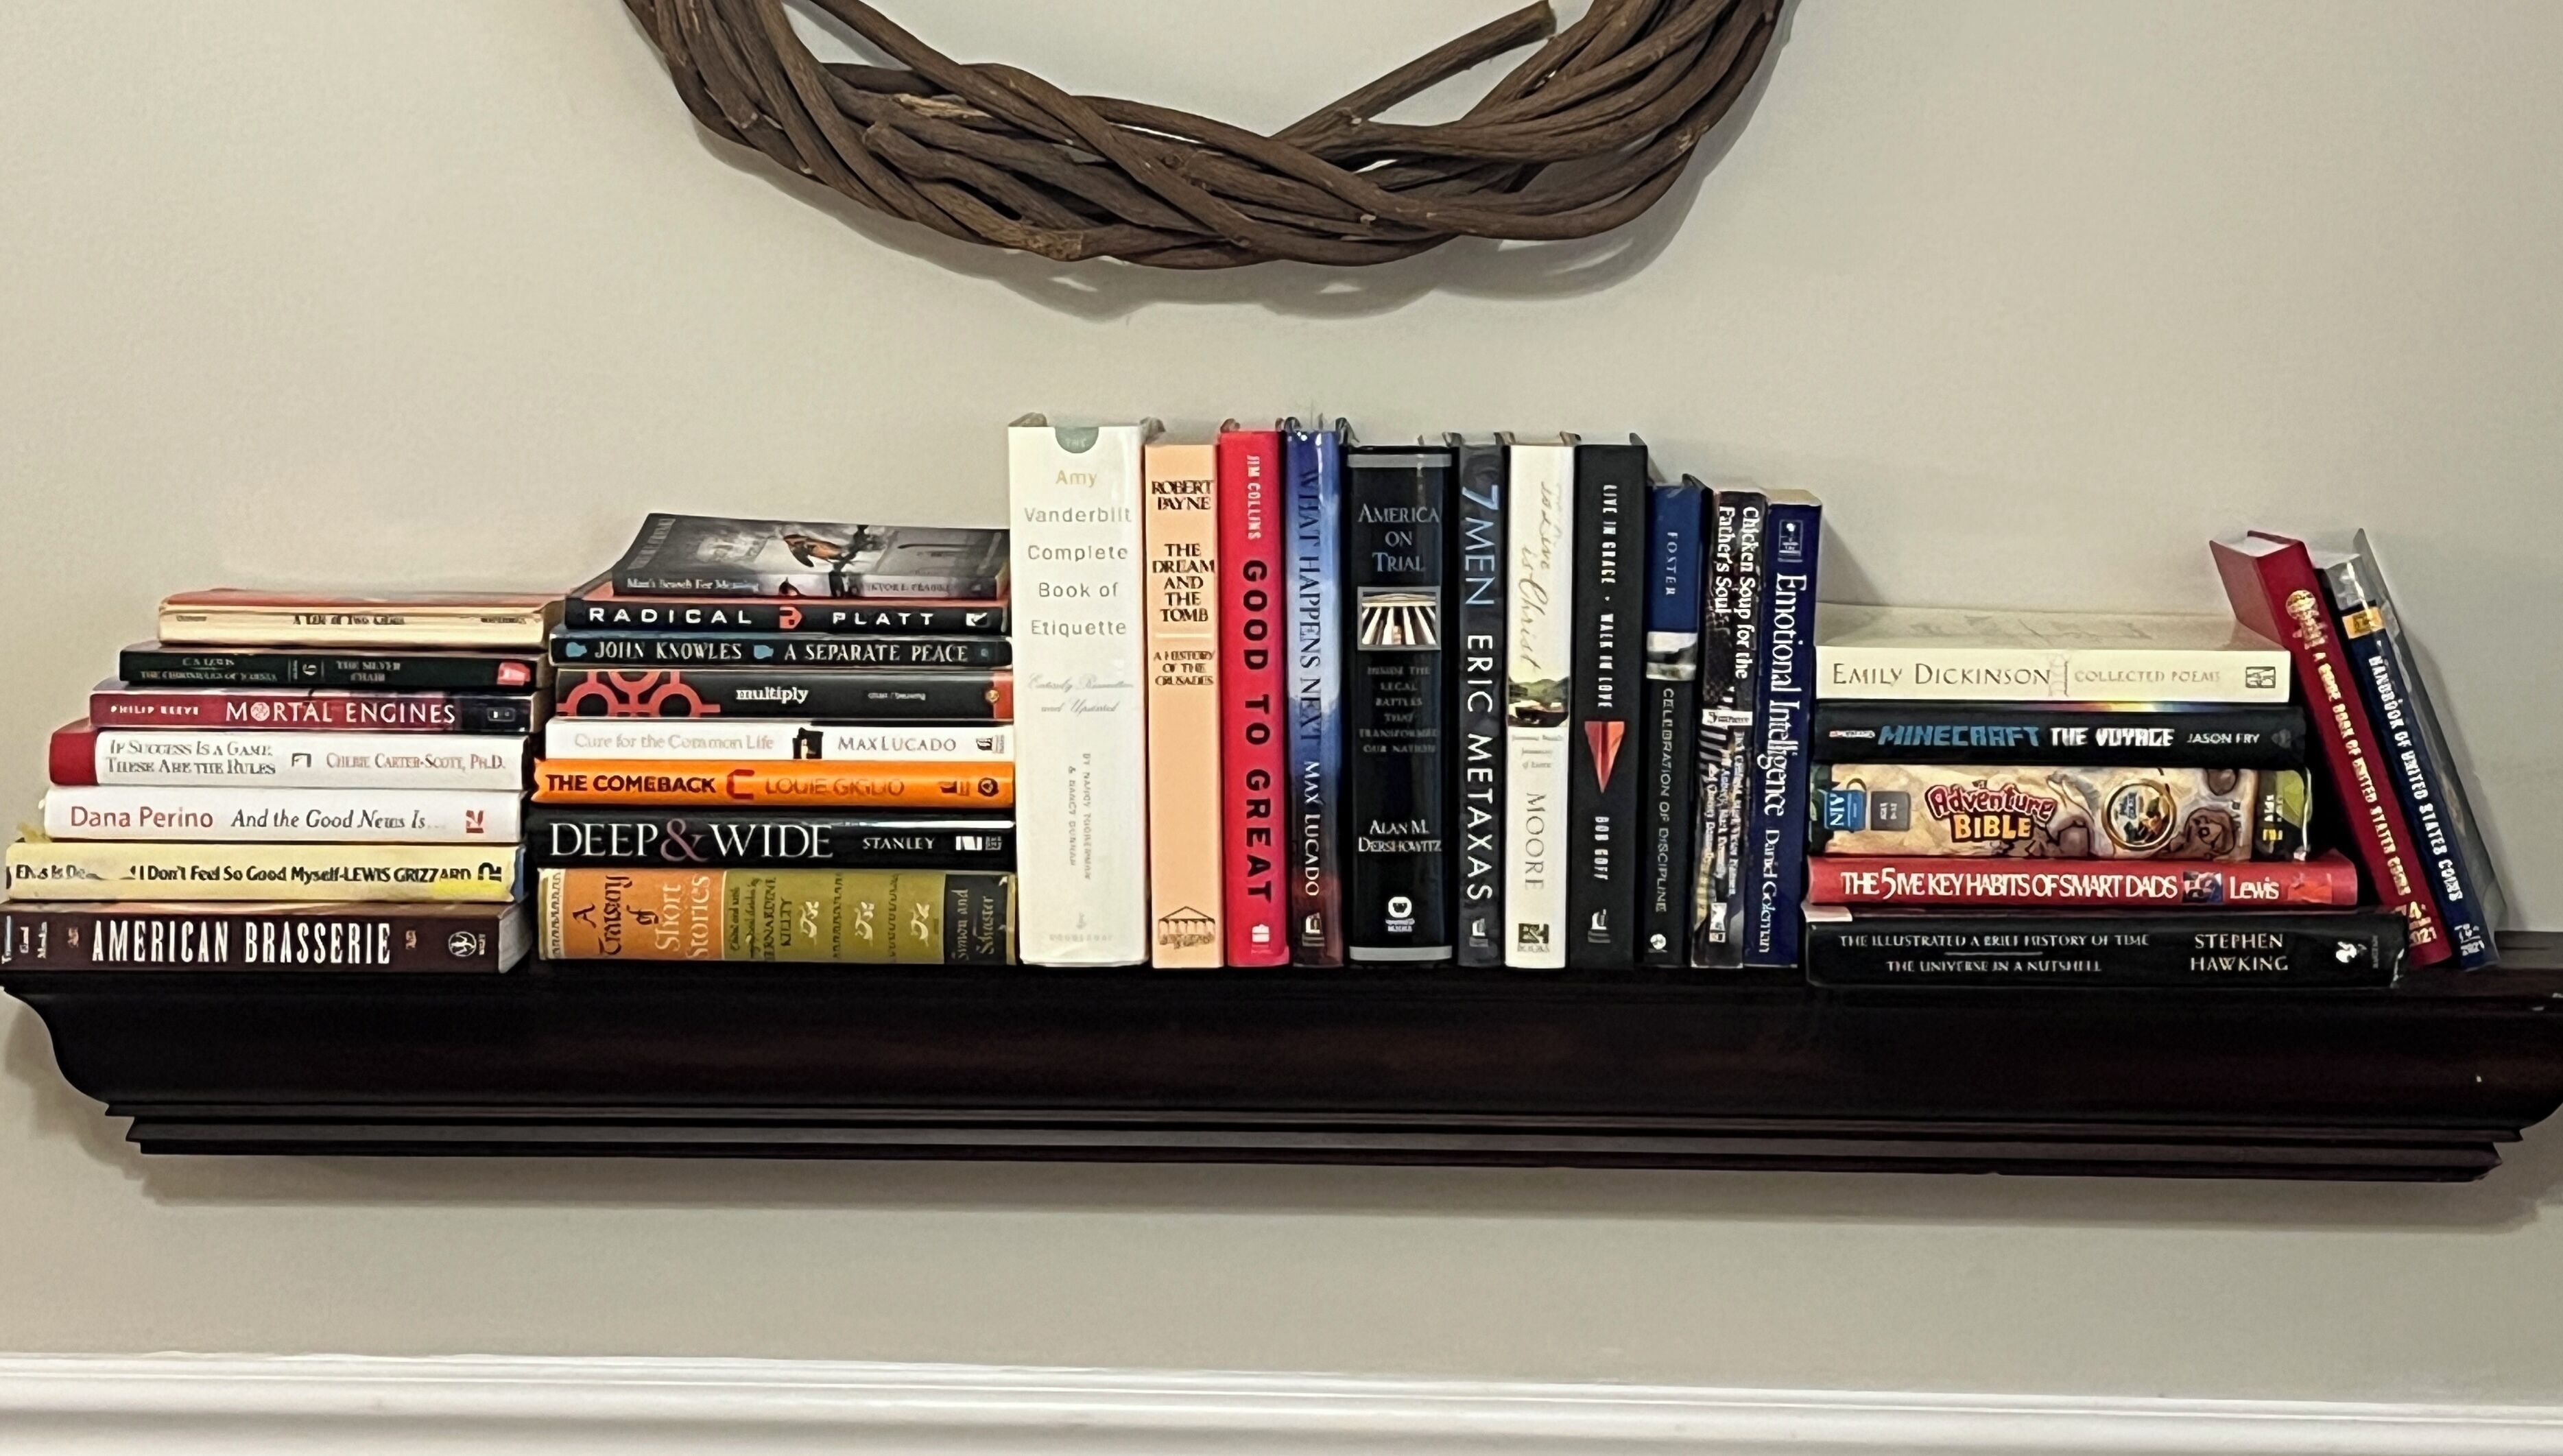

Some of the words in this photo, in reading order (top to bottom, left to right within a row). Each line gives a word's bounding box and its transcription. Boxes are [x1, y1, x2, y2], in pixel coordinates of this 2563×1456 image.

[1055, 469, 1097, 488] Amy
[1246, 455, 1261, 478] JIM
[1152, 479, 1214, 495] ROBERT
[1462, 484, 1500, 511] 7
[1023, 506, 1132, 523] Vanderbilt
[1157, 496, 1211, 510] PAYNE
[1247, 482, 1263, 541] COLLINS
[1298, 469, 1322, 547] WHAT
[1357, 503, 1440, 523] AMERICA
[1164, 542, 1202, 558] THE
[1384, 530, 1413, 547] ON
[1715, 505, 1737, 573] Father's
[1739, 505, 1761, 573] Chicken
[1027, 545, 1129, 562] Complete
[1372, 551, 1427, 572] TRIAL
[1464, 516, 1496, 606] MEN
[1665, 532, 1679, 595] FOSTER
[1152, 559, 1215, 574] DREAM
[1038, 582, 1091, 598] Book
[1099, 582, 1119, 598] of
[1164, 575, 1204, 590] AND
[1714, 575, 1733, 614] Soul
[1164, 591, 1202, 606] THE
[1733, 575, 1756, 620] Soup
[589, 606, 752, 625] RADICAL
[832, 611, 933, 626] PLATT
[1160, 608, 1208, 623] TOMB
[1242, 560, 1269, 671] GOOD
[1298, 556, 1322, 670] HAPPENS
[1518, 575, 1549, 671] Christ
[1031, 619, 1127, 638] Etiquette
[1735, 624, 1756, 649] for
[1770, 572, 1808, 693] Emotional
[594, 641, 645, 659] JOHN
[656, 642, 742, 660] KNOWLES
[784, 644, 796, 661] A
[804, 644, 901, 662] SEPARATE
[911, 645, 969, 663] PEACE
[1466, 634, 1494, 713] ERIC
[1735, 651, 1754, 680] the
[1833, 663, 1903, 687] EMILY
[1914, 663, 2051, 685] DICKINSON
[2073, 670, 2166, 683] COLLECTED
[2171, 670, 2221, 683] POEMS
[735, 687, 809, 704] multiply
[110, 704, 155, 716] PHILIP
[225, 700, 333, 723] MORTAL
[345, 702, 456, 724] ENGINES
[1243, 693, 1272, 745] TO
[1300, 676, 1322, 743] NEXT
[574, 733, 612, 749] Cure
[615, 733, 637, 748] for
[641, 733, 665, 749] the
[667, 735, 743, 750] Common
[746, 735, 775, 750] Life
[837, 735, 878, 752] MAX
[881, 735, 957, 752] LUCADO
[1659, 687, 1676, 798] CELEBRATION
[1877, 724, 2040, 748] MINECRAFT
[2049, 726, 2090, 747] THE
[2095, 727, 2176, 748] VOYAGE
[2186, 732, 2233, 745] JASON
[2235, 732, 2261, 745] FRY
[1756, 699, 1801, 817] Intelligence
[544, 774, 588, 792] THE
[593, 775, 717, 793] COMEBACK
[765, 778, 828, 796] LOUIE
[833, 778, 905, 796] GIGLIO
[1304, 761, 1322, 806] MAX
[1658, 800, 1671, 822] OF
[1828, 793, 1846, 826] NIV
[1927, 784, 2057, 822] Adventure
[70, 805, 131, 828] Dana
[139, 806, 214, 828] Perino
[230, 808, 269, 828] And
[273, 808, 300, 828] the
[305, 809, 355, 828] Good
[357, 809, 406, 829] News
[1466, 732, 1494, 900] METAXAS
[1953, 813, 2033, 840] BIBLE
[862, 836, 936, 850] STANLEY
[1245, 768, 1273, 904] GREAT
[1525, 792, 1548, 890] MOORE
[1304, 813, 1321, 896] LUCADO
[1763, 829, 1781, 879] Daniel
[147, 865, 187, 881] Don't
[189, 865, 221, 881] Feel
[222, 866, 243, 881] So
[245, 866, 287, 882] Good
[1655, 827, 1670, 913] DISCIPLINE
[1840, 872, 1880, 896] THE
[1927, 872, 1965, 897] KEY
[1966, 873, 2031, 898] HABITS
[2031, 874, 2058, 898] OF
[2058, 874, 2125, 899] SMART
[2126, 875, 2178, 899] DADS
[2229, 876, 2280, 900] Lewis
[572, 902, 597, 929] A
[626, 903, 660, 926] of
[654, 883, 683, 952] Short
[687, 874, 711, 960] Stories
[1759, 880, 1778, 954] Goleman
[91, 919, 229, 964] AMERICAN
[244, 920, 392, 964] BRASSERIE
[1838, 935, 1868, 947] THE
[1872, 935, 1966, 947] ILLUSTRATED
[2194, 933, 2284, 950] STEPHEN
[1886, 961, 1915, 972] THE
[2190, 955, 2289, 972] HAWKING
